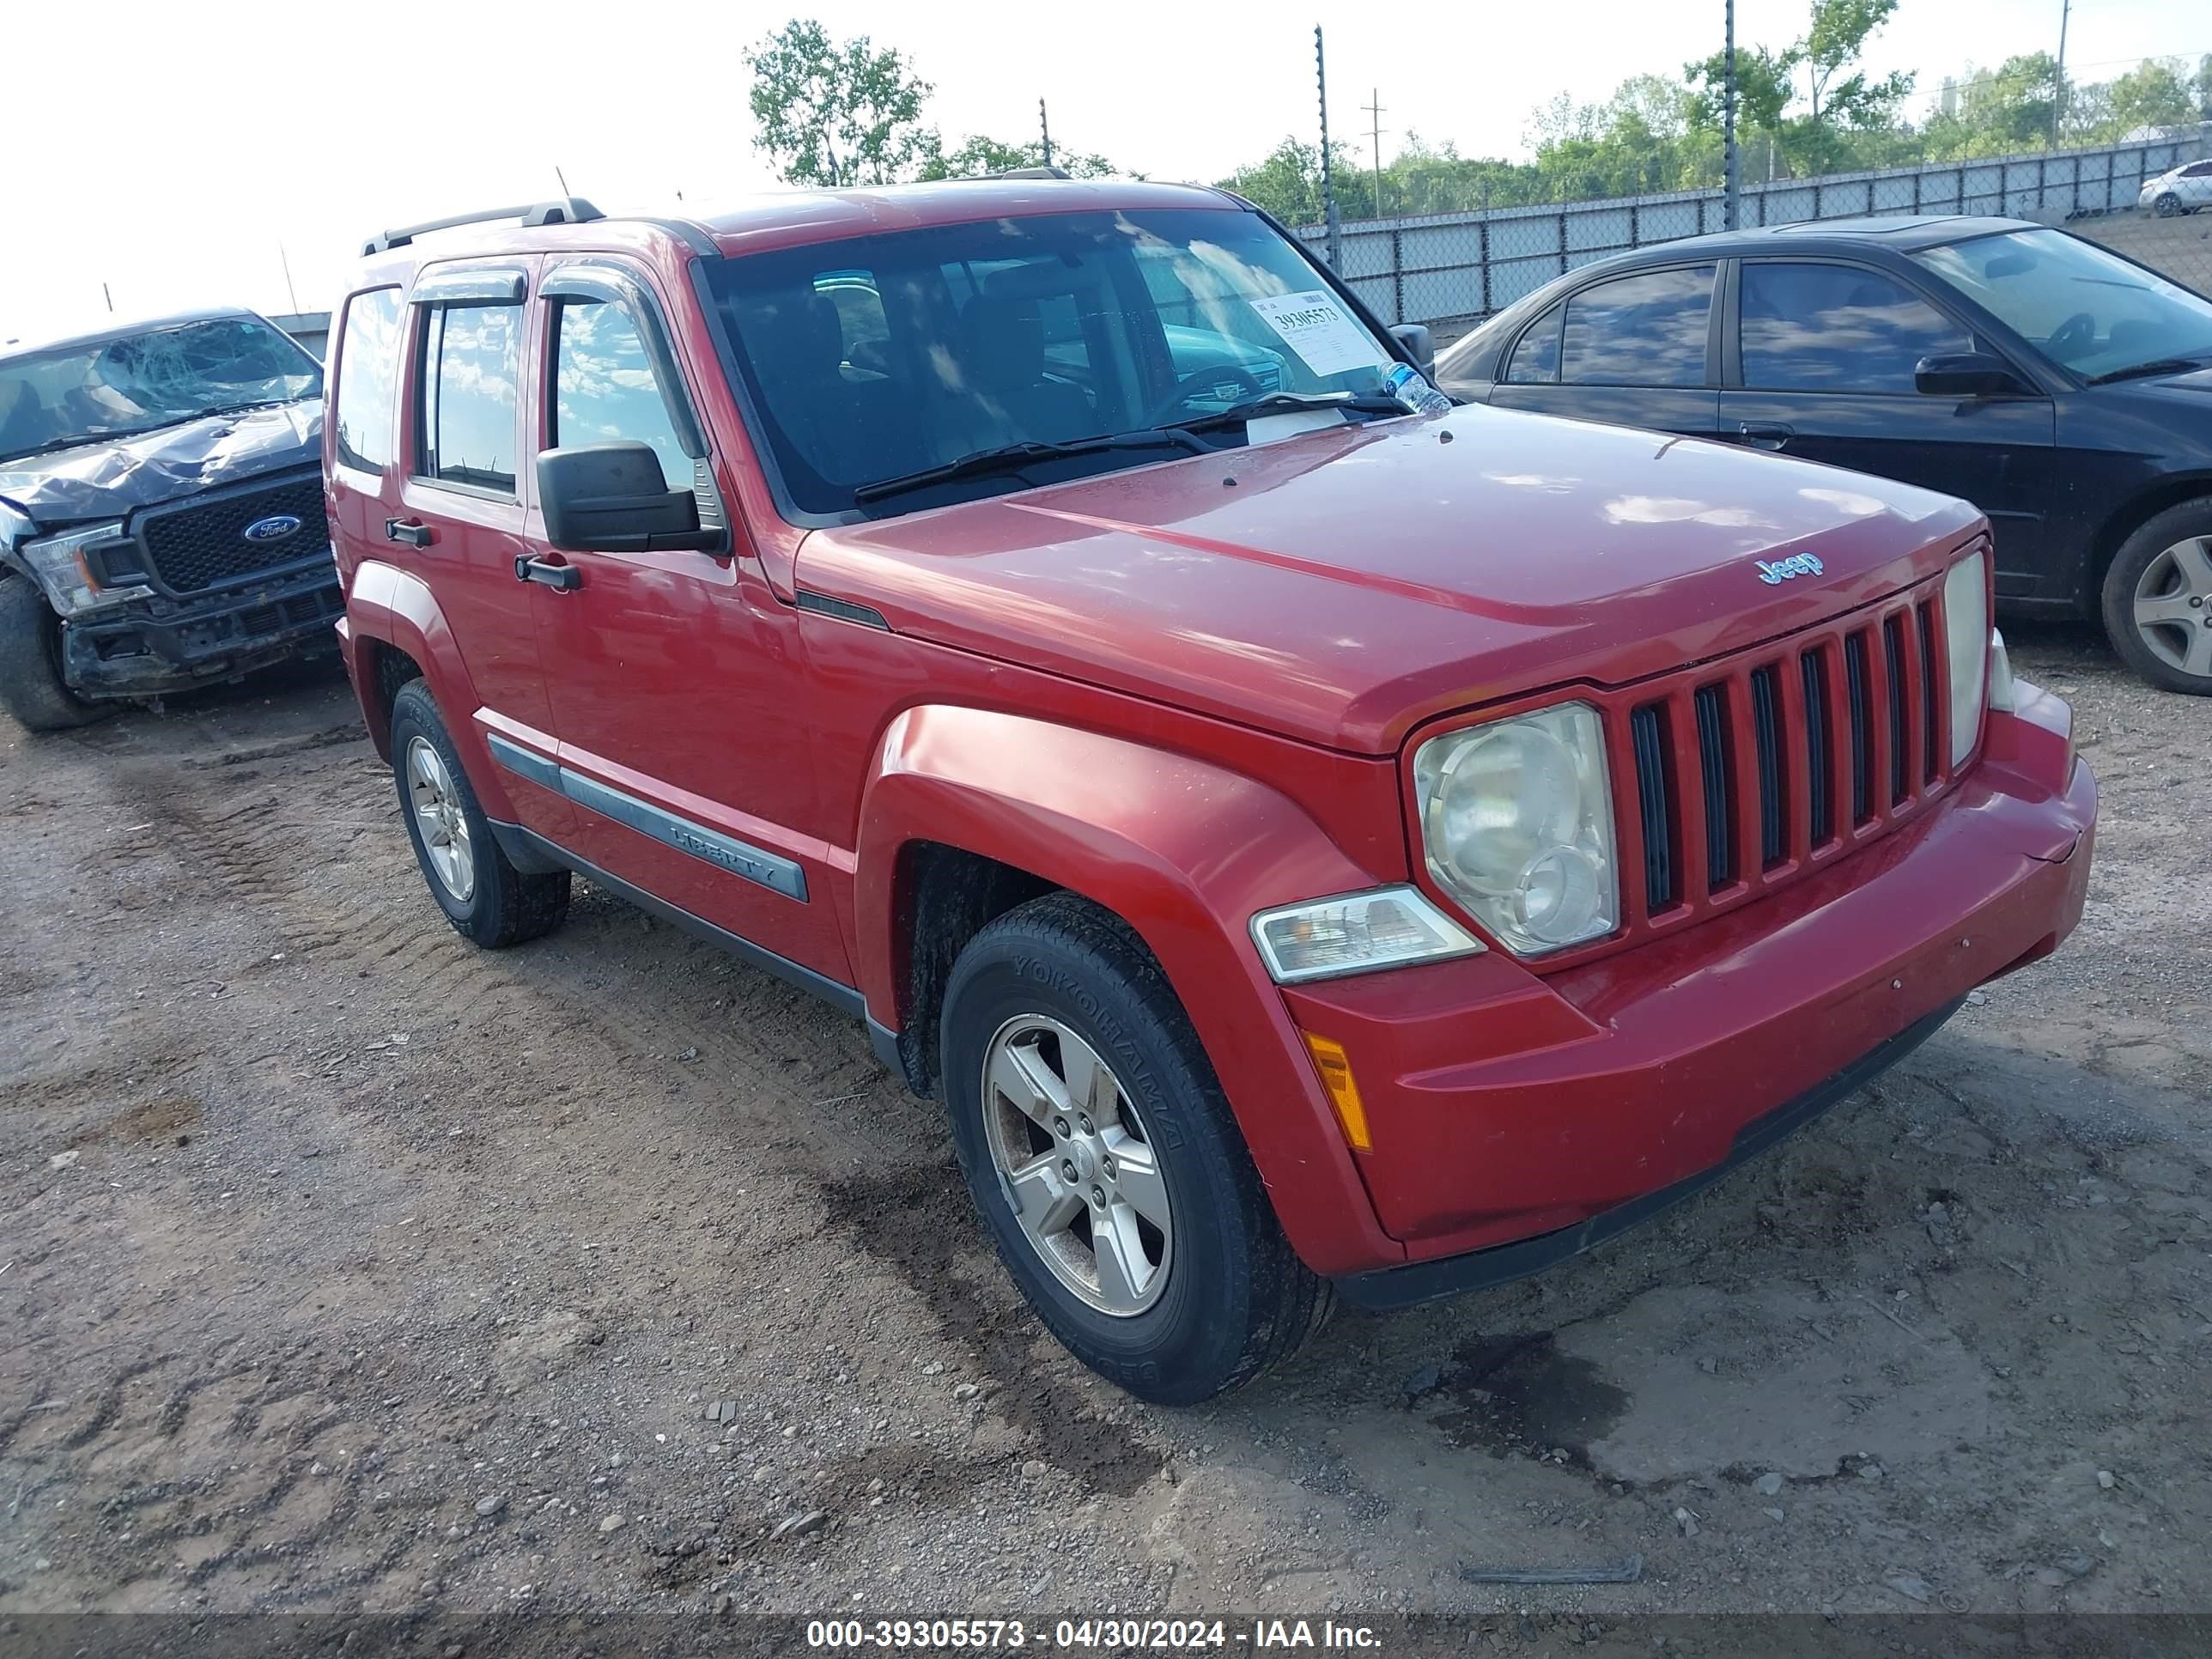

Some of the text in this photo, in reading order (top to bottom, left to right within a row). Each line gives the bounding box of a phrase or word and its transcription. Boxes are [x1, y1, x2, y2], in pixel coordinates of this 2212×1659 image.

[1275, 307, 1340, 330] 39305573
[259, 522, 289, 538] Ford
[1754, 552, 1824, 585] Jeep
[670, 827, 775, 881] LIBERTY
[1012, 953, 1187, 1151] YOKOHAMA
